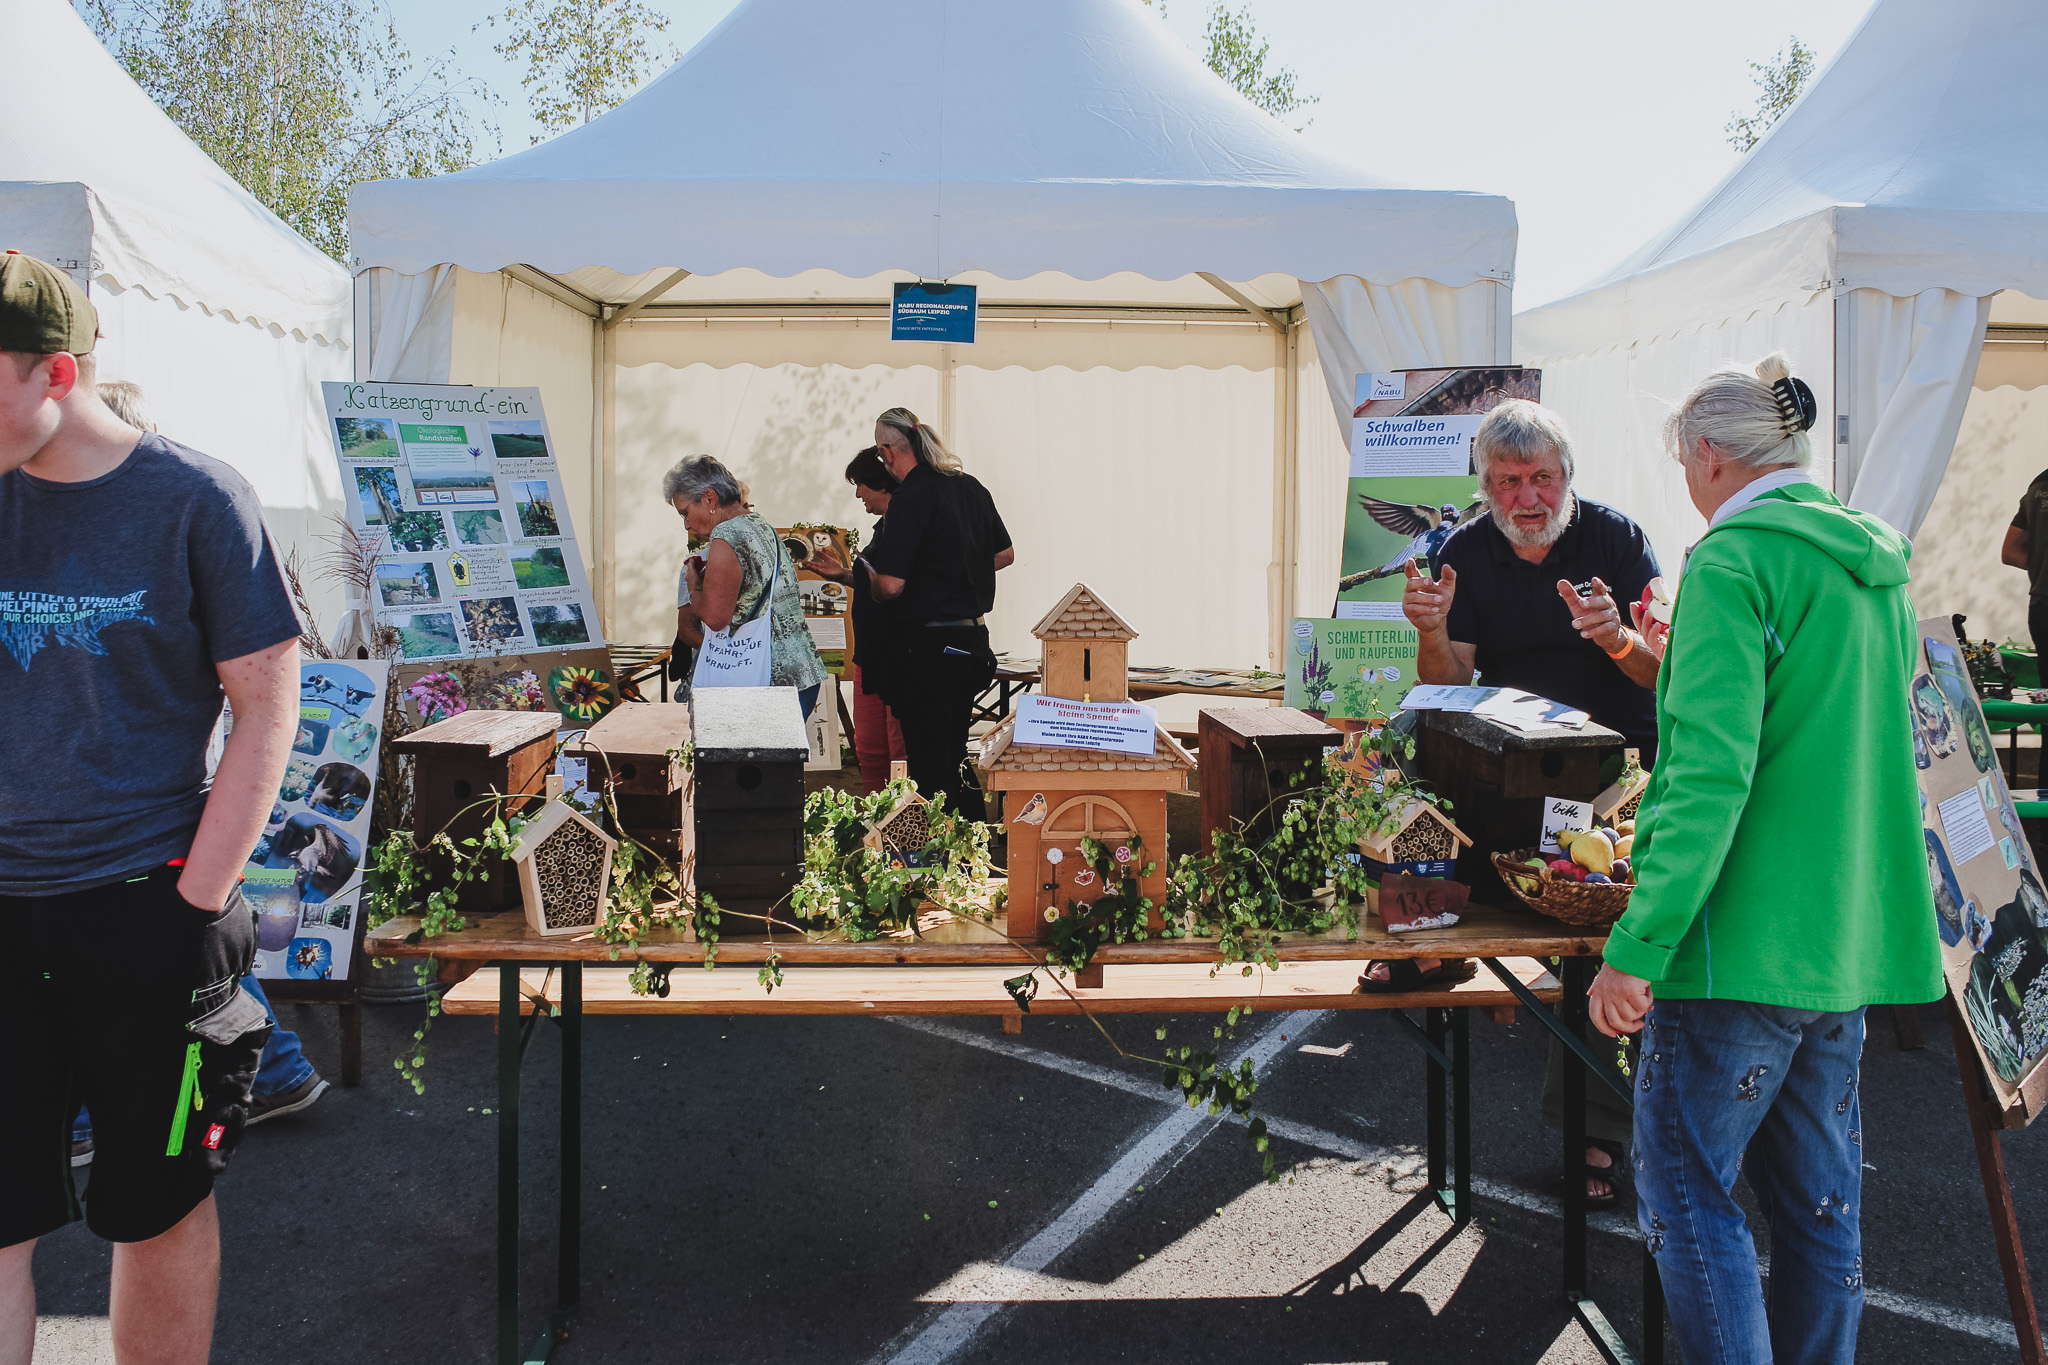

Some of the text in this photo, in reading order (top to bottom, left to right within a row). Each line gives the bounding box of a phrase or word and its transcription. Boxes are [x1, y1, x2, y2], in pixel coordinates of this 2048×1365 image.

[915, 303, 969, 311] REGIONALGRUPPE
[417, 426, 458, 435] Ökologischer
[1365, 419, 1445, 434] Schwalben
[418, 434, 462, 442] Randstreifen
[1364, 432, 1462, 447] willkommen!
[18, 591, 65, 603] LITTER
[3, 605, 144, 624] OUR CHOICES AND ACTIONS
[62, 602, 78, 613] TO
[1327, 629, 1418, 645] SCHMETTERLIN
[1335, 647, 1355, 660] UND
[1036, 698, 1141, 715] Wir freuen uns über eine
[1058, 709, 1120, 722] kleine Spende
[1552, 801, 1579, 818] bitte
[1396, 890, 1443, 916] 13€
